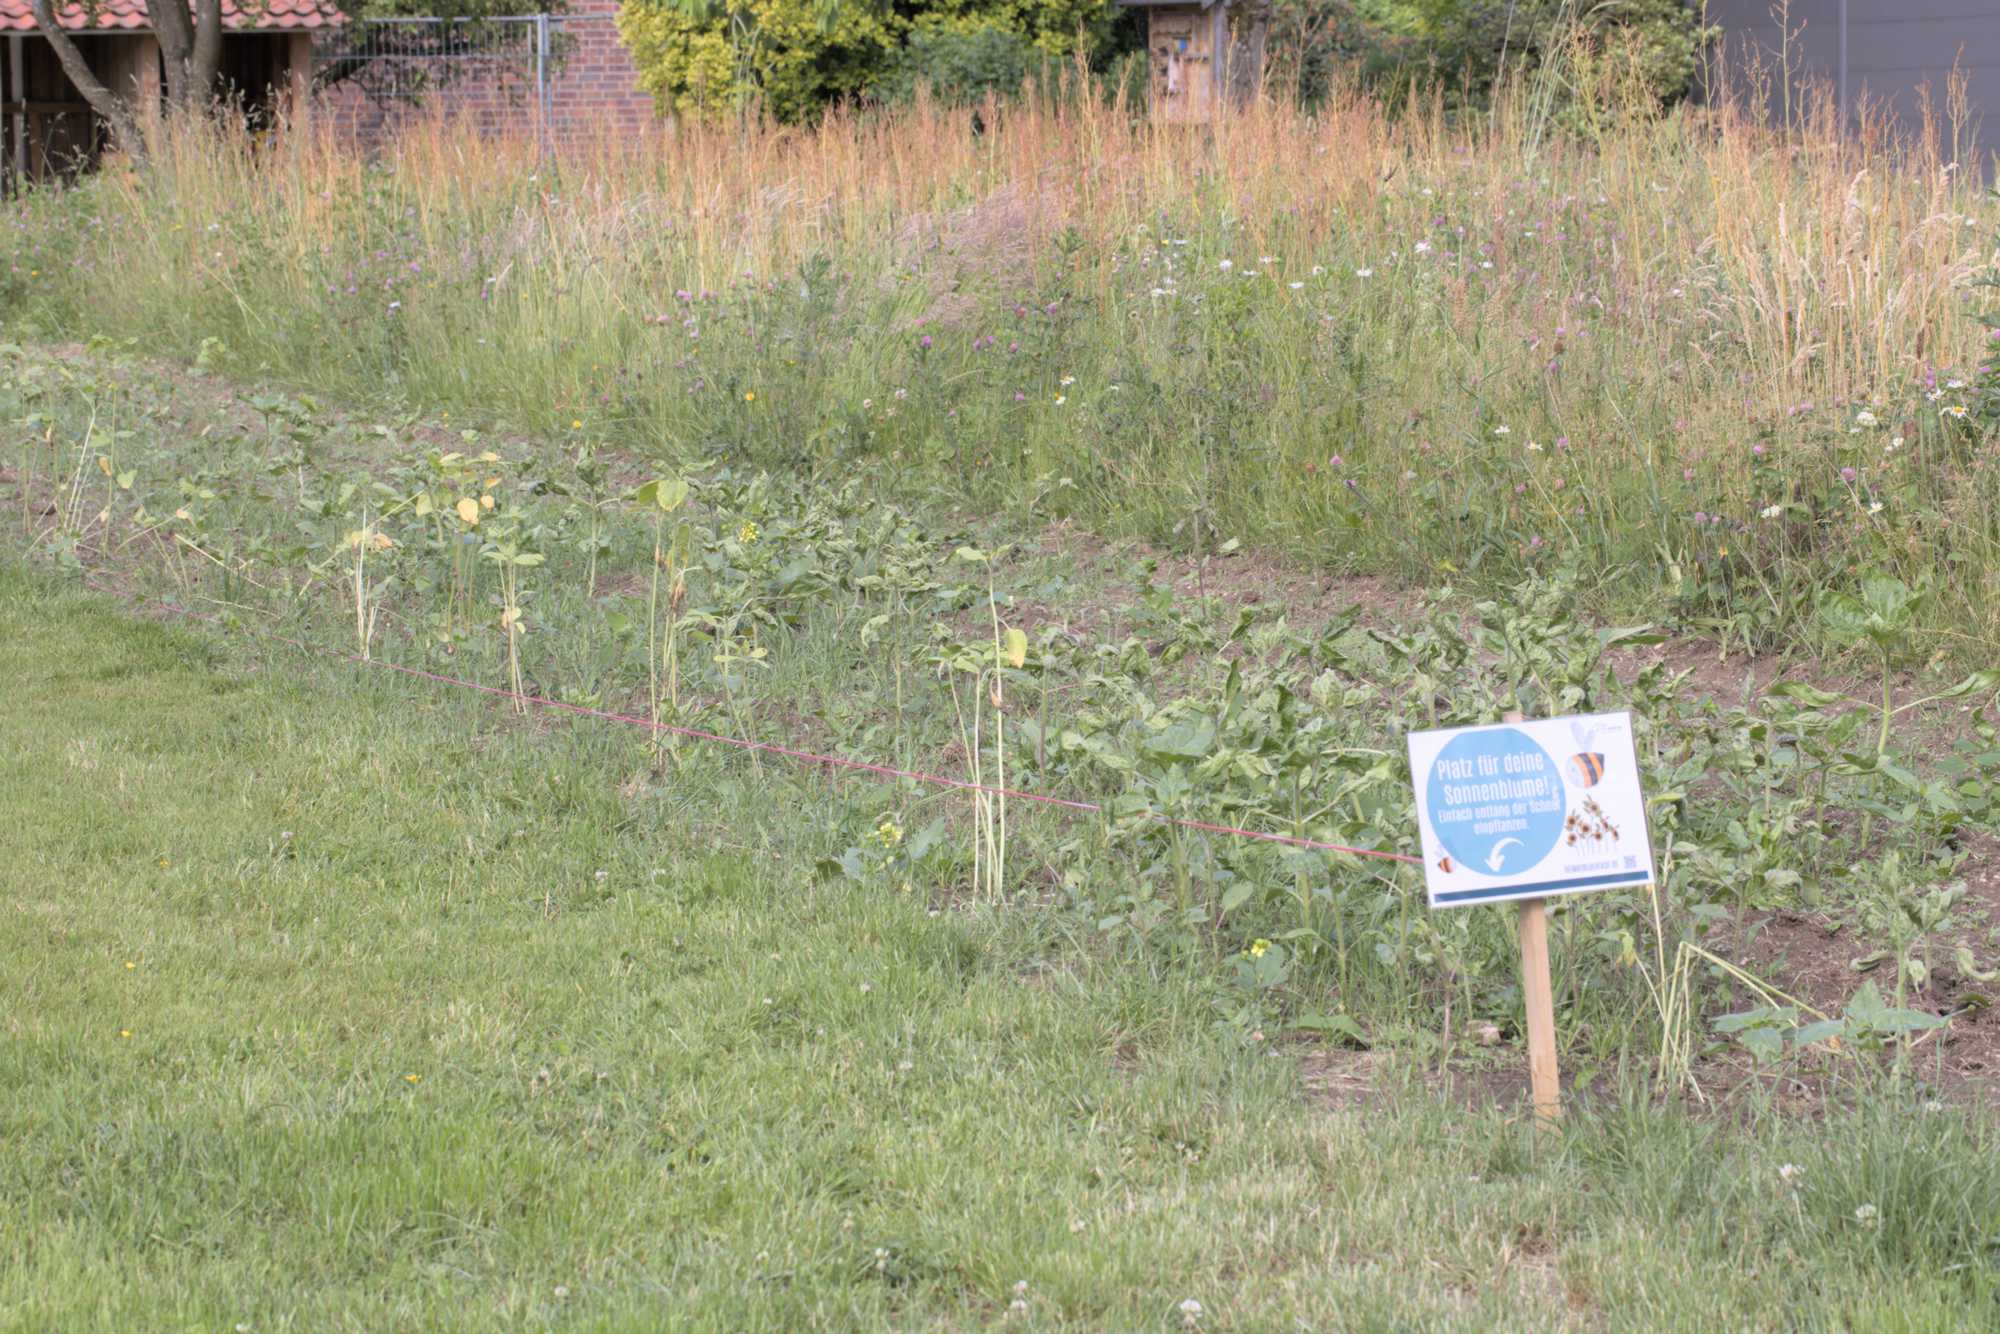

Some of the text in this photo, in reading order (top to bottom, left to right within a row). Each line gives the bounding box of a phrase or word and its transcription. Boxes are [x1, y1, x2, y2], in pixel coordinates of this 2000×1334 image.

[1437, 752, 1544, 781] Platz für deine
[1444, 776, 1549, 805] Sonnenblume!
[1438, 807, 1472, 823] Einfach
[1513, 801, 1527, 816] der
